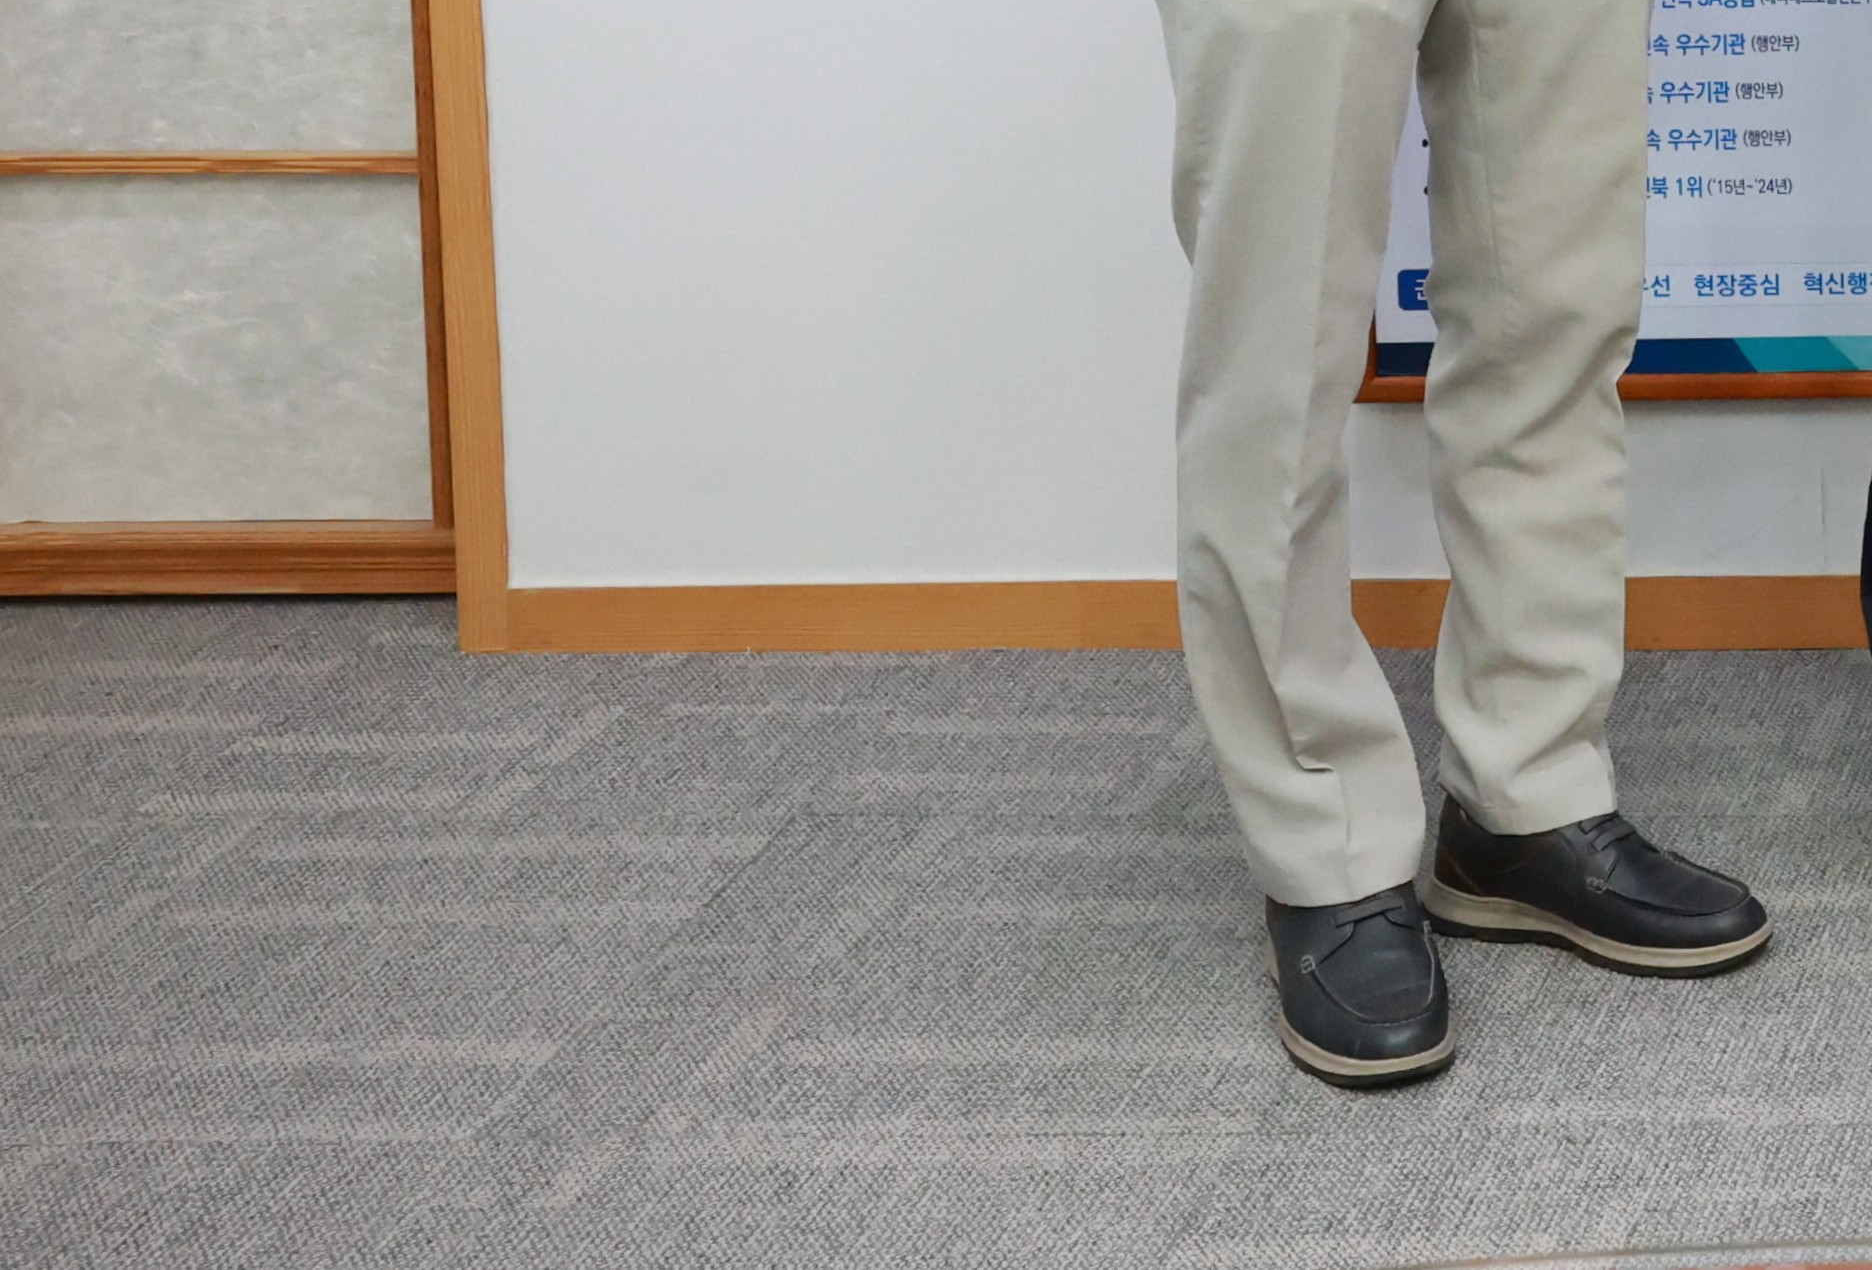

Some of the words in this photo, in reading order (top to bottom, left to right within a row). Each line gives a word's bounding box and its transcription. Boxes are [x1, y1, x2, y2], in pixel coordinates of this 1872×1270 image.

[1675, 33, 1746, 57] 우수기관
[1751, 33, 1802, 53] (행안부)
[1659, 80, 1731, 104] 우수기관
[1733, 81, 1784, 100] (행안부)
[1667, 128, 1738, 151] 우수기관
[1741, 129, 1793, 150] (행안부)
[1676, 175, 1703, 199] 1위
[1692, 271, 1782, 299] 현장중심
